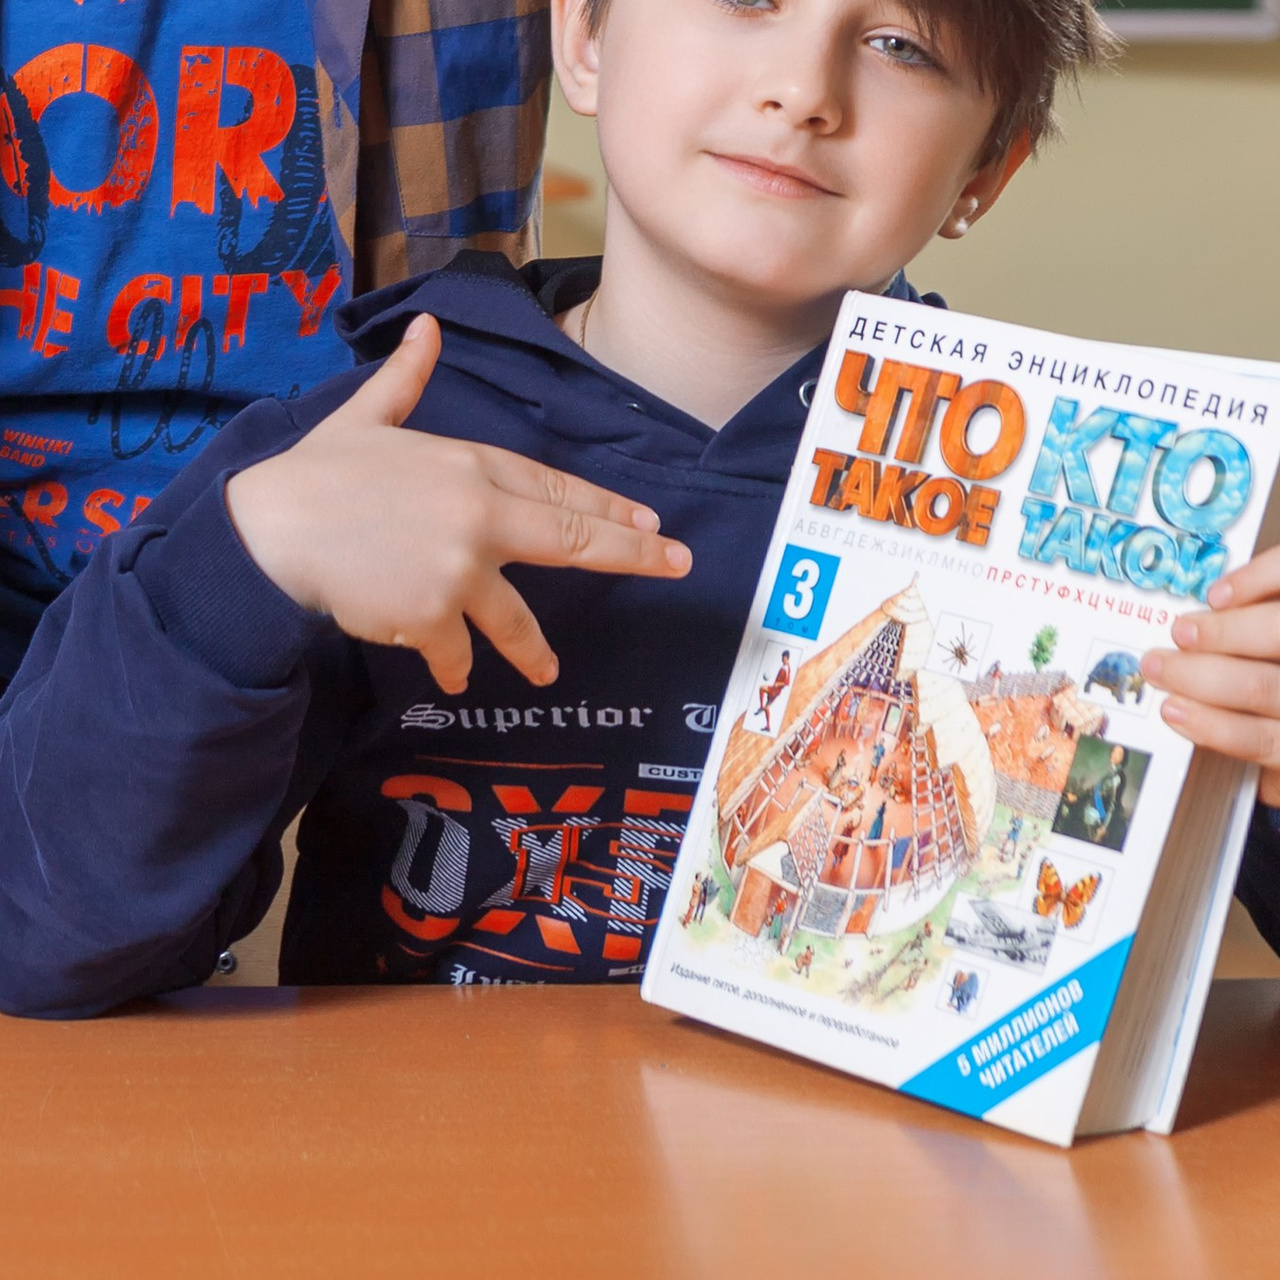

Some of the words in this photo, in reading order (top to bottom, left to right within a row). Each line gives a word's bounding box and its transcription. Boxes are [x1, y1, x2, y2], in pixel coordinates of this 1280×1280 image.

[107, 264, 342, 360] CITY
[835, 349, 1027, 481] ЧТО
[849, 317, 988, 363] ДЕТСКАЯ
[1008, 351, 1269, 426] ЭНЦИКЛОПЕДИЯ
[0, 445, 46, 468] BAND
[3, 428, 74, 456] WINKIKI
[1028, 395, 1254, 535] КТО
[810, 447, 1002, 547] ТАКОЕ
[783, 558, 820, 619] 3
[1018, 497, 1229, 604] ТАКОЙ
[400, 700, 653, 733] Superior
[669, 961, 711, 985] Издание
[743, 990, 808, 1019] дополненное
[819, 1014, 900, 1050] переработанное
[971, 978, 1084, 1068] МИЛЛИОНОВ
[979, 1010, 1080, 1089] ЧИТАТЕЛЕЙ
